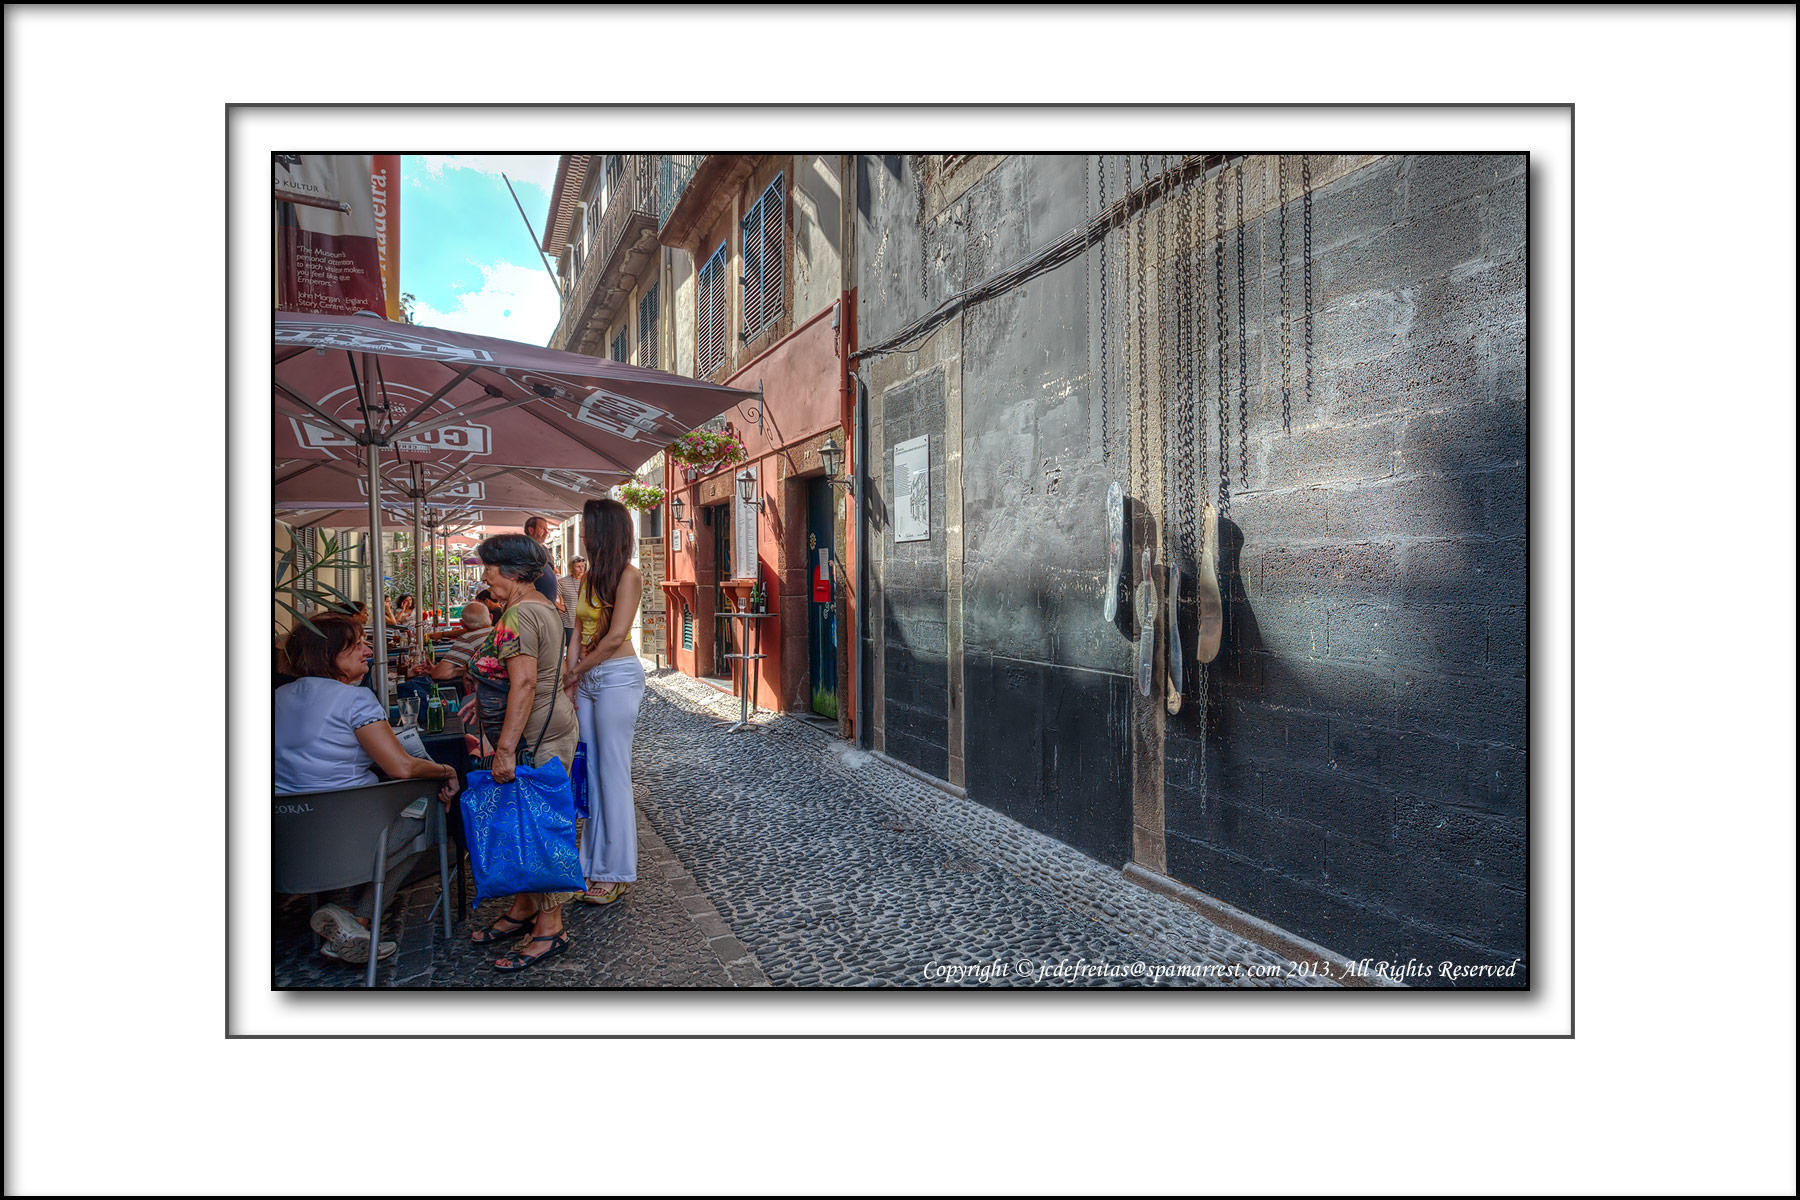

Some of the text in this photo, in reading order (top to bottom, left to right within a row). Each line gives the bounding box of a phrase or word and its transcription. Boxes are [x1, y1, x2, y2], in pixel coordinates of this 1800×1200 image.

[284, 178, 319, 193] KULTUR
[296, 254, 326, 263] personal
[311, 270, 325, 278] feel
[298, 291, 313, 299] John
[314, 293, 341, 303] Morgan
[298, 298, 317, 309] Story
[319, 300, 345, 311] Centre
